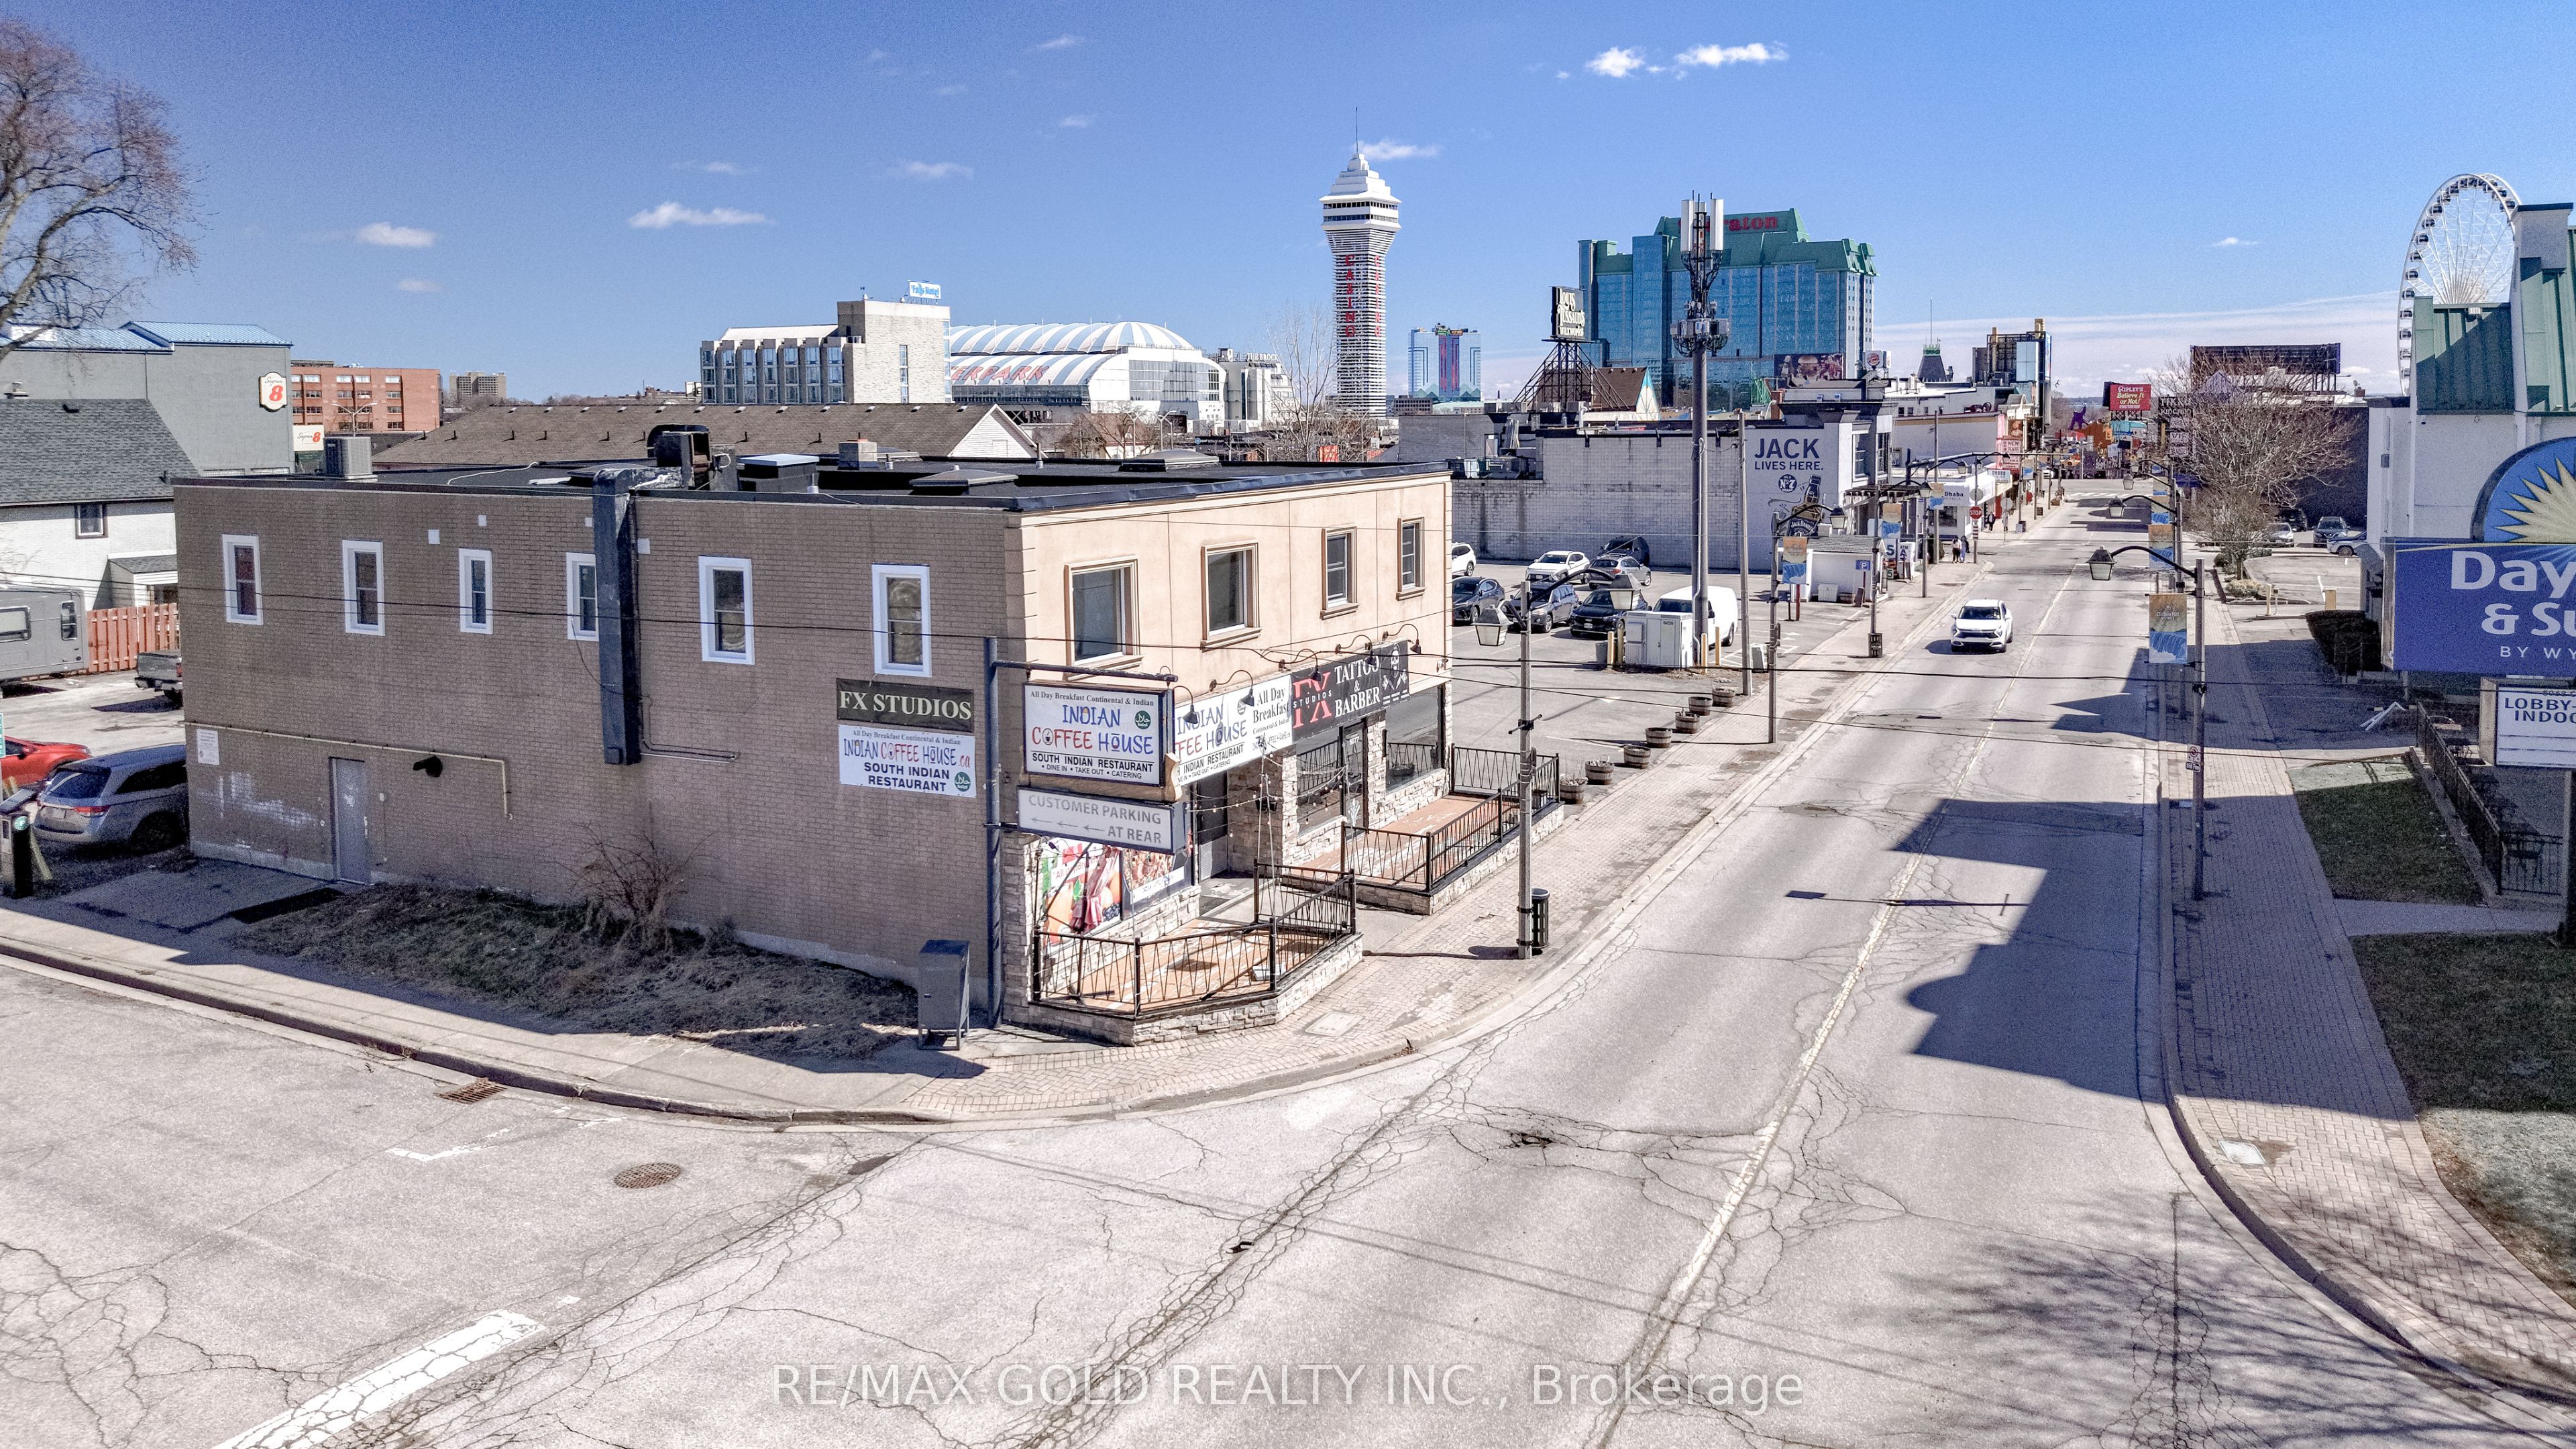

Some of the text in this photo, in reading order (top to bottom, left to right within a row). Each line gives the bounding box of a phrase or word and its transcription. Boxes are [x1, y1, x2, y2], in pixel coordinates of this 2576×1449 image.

[1345, 254, 1356, 337] CASINO
[1246, 352, 1259, 361] THE
[265, 376, 283, 386] Super
[951, 365, 1050, 380] ERPARK
[269, 385, 283, 402] 8
[297, 431, 321, 442] Super 8
[1754, 438, 1820, 459] JACK
[1754, 461, 1824, 470] LIVES HERE.
[1886, 545, 1895, 555] 5
[2481, 603, 2519, 635] &
[2500, 646, 2528, 657] BY
[1354, 680, 1360, 692] &
[839, 690, 972, 720] FX STUDIOS
[1041, 692, 1053, 700] Day
[1055, 692, 1085, 701] Breakfast
[1086, 695, 1124, 704] Continental
[1257, 688, 1286, 706] All Day
[1293, 690, 1332, 708] STUDIOS
[1334, 686, 1381, 718] BARBER
[1063, 704, 1121, 728] INDIAN
[874, 731, 900, 739] Breakfast
[902, 734, 934, 743] Continental
[1098, 732, 1154, 755] HOUSE
[1206, 720, 1248, 750] HOUSE
[844, 739, 879, 759] INDIAN
[1175, 735, 1203, 762] FEE
[1032, 753, 1154, 772] SOUTH INDIAN RESTAURANT
[1183, 759, 1204, 773] INDIAN
[1208, 744, 1244, 764] RESTAURANT
[864, 761, 950, 780] SOUTH INDIAN
[1112, 771, 1142, 780] CATERING
[1191, 770, 1201, 778] TAKE
[1201, 767, 1210, 776] OUT
[1214, 759, 1231, 770] CATERING
[868, 775, 947, 792] RESTAURANT
[1028, 794, 1161, 824] CUSTOMER PARKING
[1108, 825, 1161, 844] AT REAR
